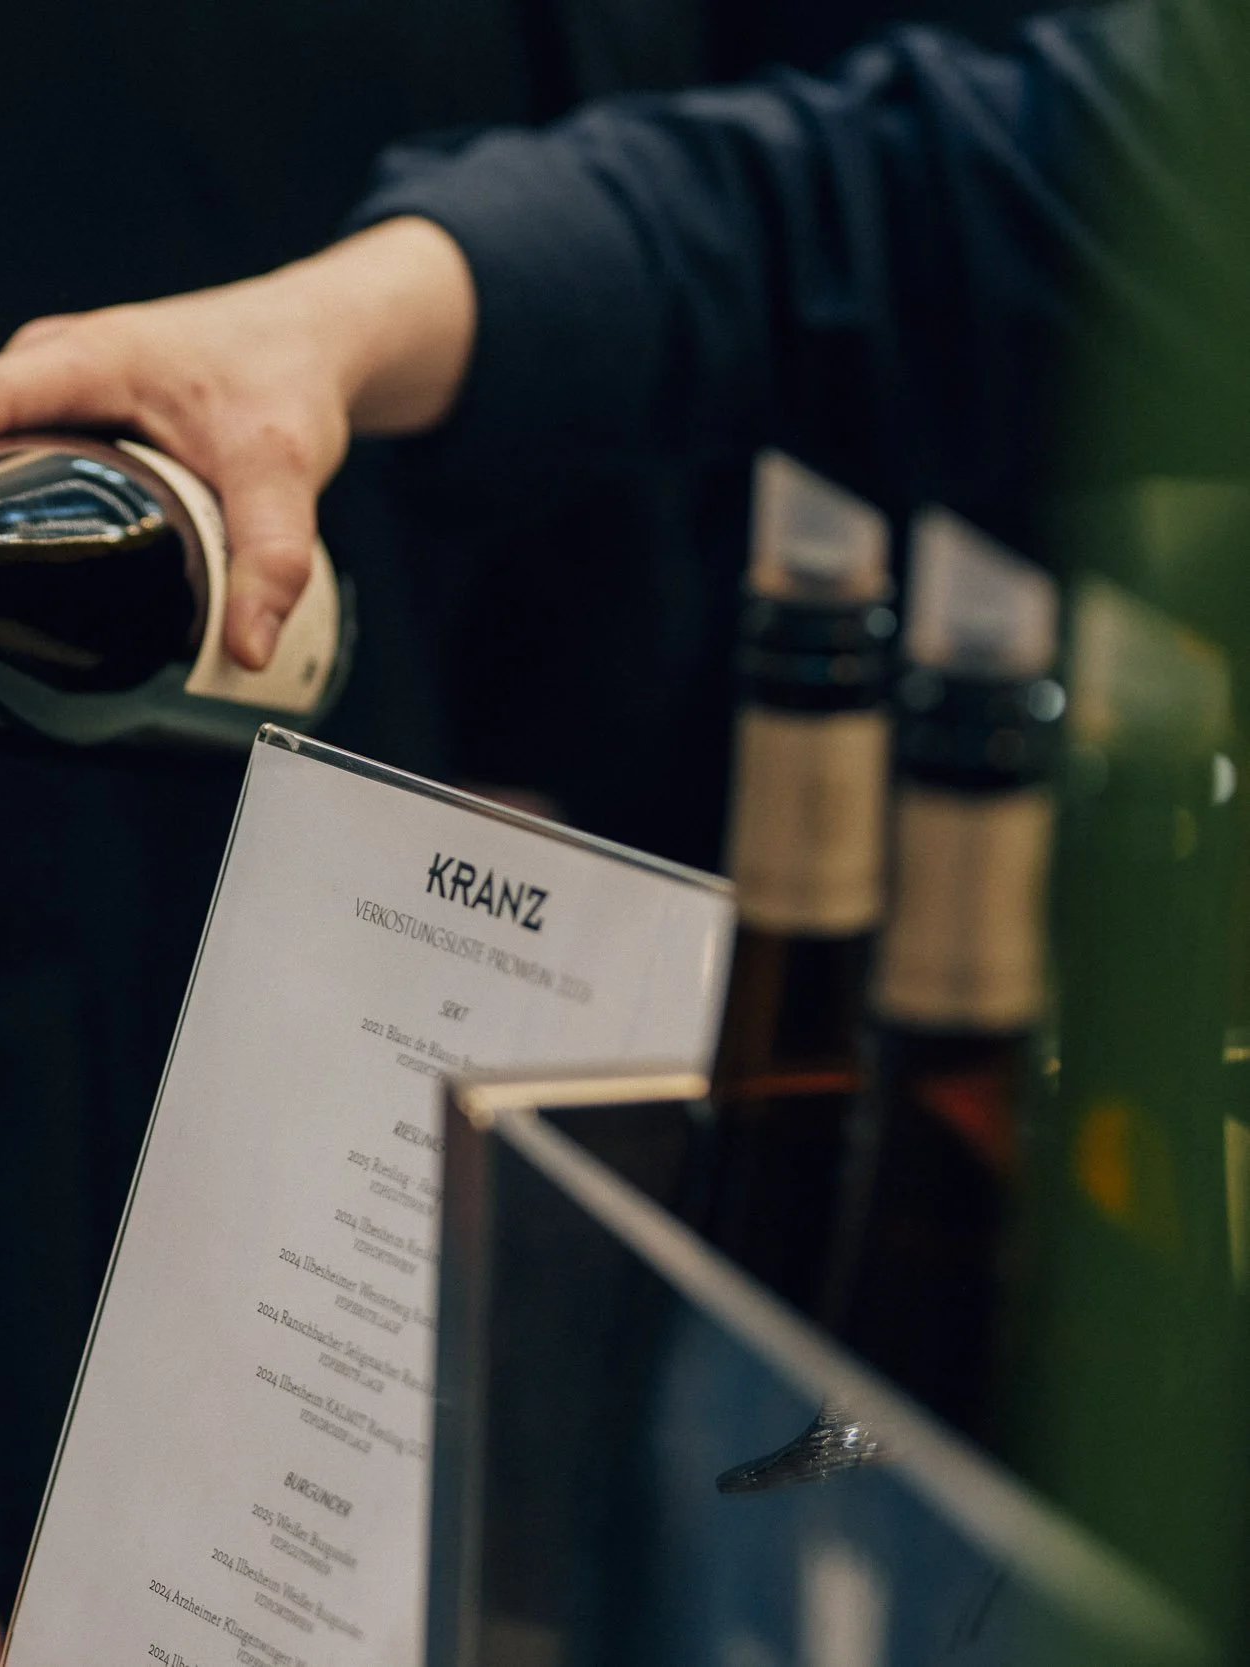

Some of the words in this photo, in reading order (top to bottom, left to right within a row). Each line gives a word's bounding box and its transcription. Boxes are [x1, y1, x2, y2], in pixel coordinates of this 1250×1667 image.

[425, 852, 550, 932] KRANZ
[354, 896, 486, 964] VERKOSTUNGSLISTE
[438, 999, 471, 1023] SEKT
[361, 1017, 385, 1037] 2021
[386, 1023, 412, 1047] Blanc
[413, 1036, 427, 1053] de
[278, 1247, 302, 1270] 2024
[302, 1254, 359, 1292] Ilbesheimer
[256, 1301, 280, 1325] 2024
[280, 1308, 344, 1352] Ranschbacher
[255, 1365, 280, 1390] 2024
[279, 1373, 324, 1408] Ilbesheim
[251, 1502, 274, 1527] 2025
[283, 1470, 354, 1517] BURGUNDER
[210, 1547, 234, 1571] 2024
[235, 1556, 281, 1593] Ilbesheim
[148, 1579, 172, 1603] 2024
[171, 1588, 221, 1629] Arzheimer
[148, 1643, 171, 1667] 2024
